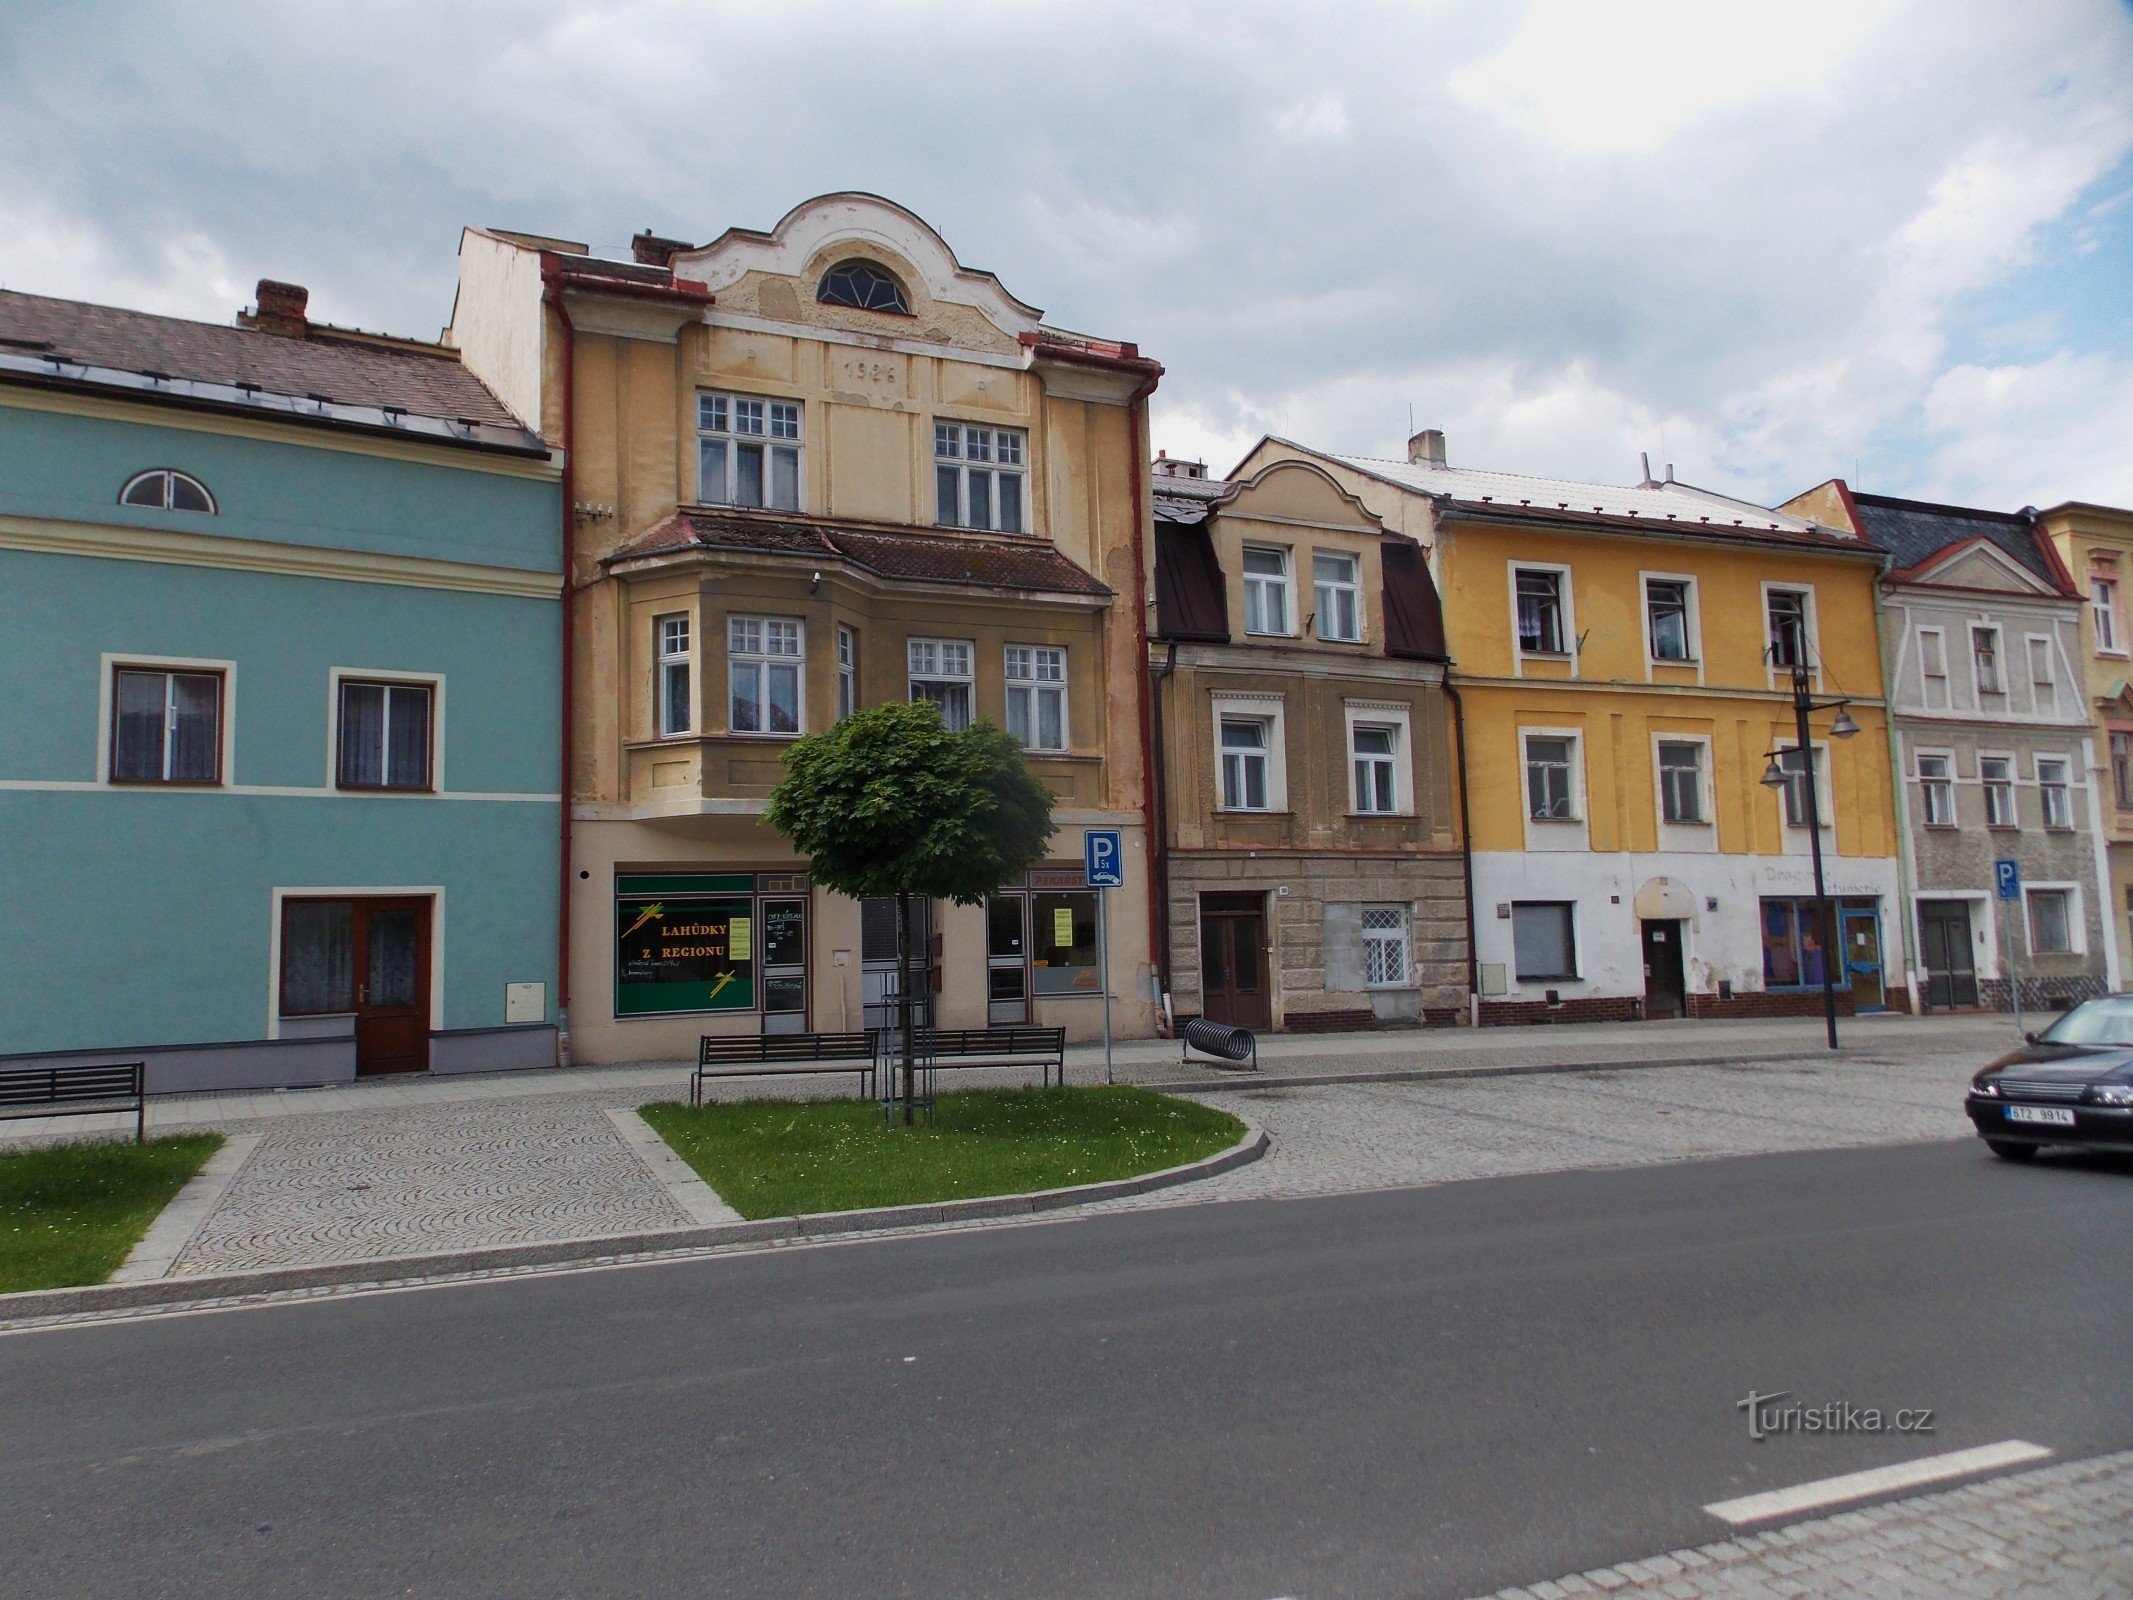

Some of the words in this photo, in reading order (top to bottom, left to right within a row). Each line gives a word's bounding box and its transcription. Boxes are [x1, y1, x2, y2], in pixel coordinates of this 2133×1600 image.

[844, 362, 895, 384] 1926
[1093, 838, 1113, 868] P
[1101, 860, 1110, 868] 5x
[1035, 874, 1084, 885] PEKAŘST
[2000, 864, 2013, 886] P
[661, 922, 727, 936] LAHŮDKY
[661, 946, 725, 958] REGIONU
[2040, 1109, 2067, 1121] 9914
